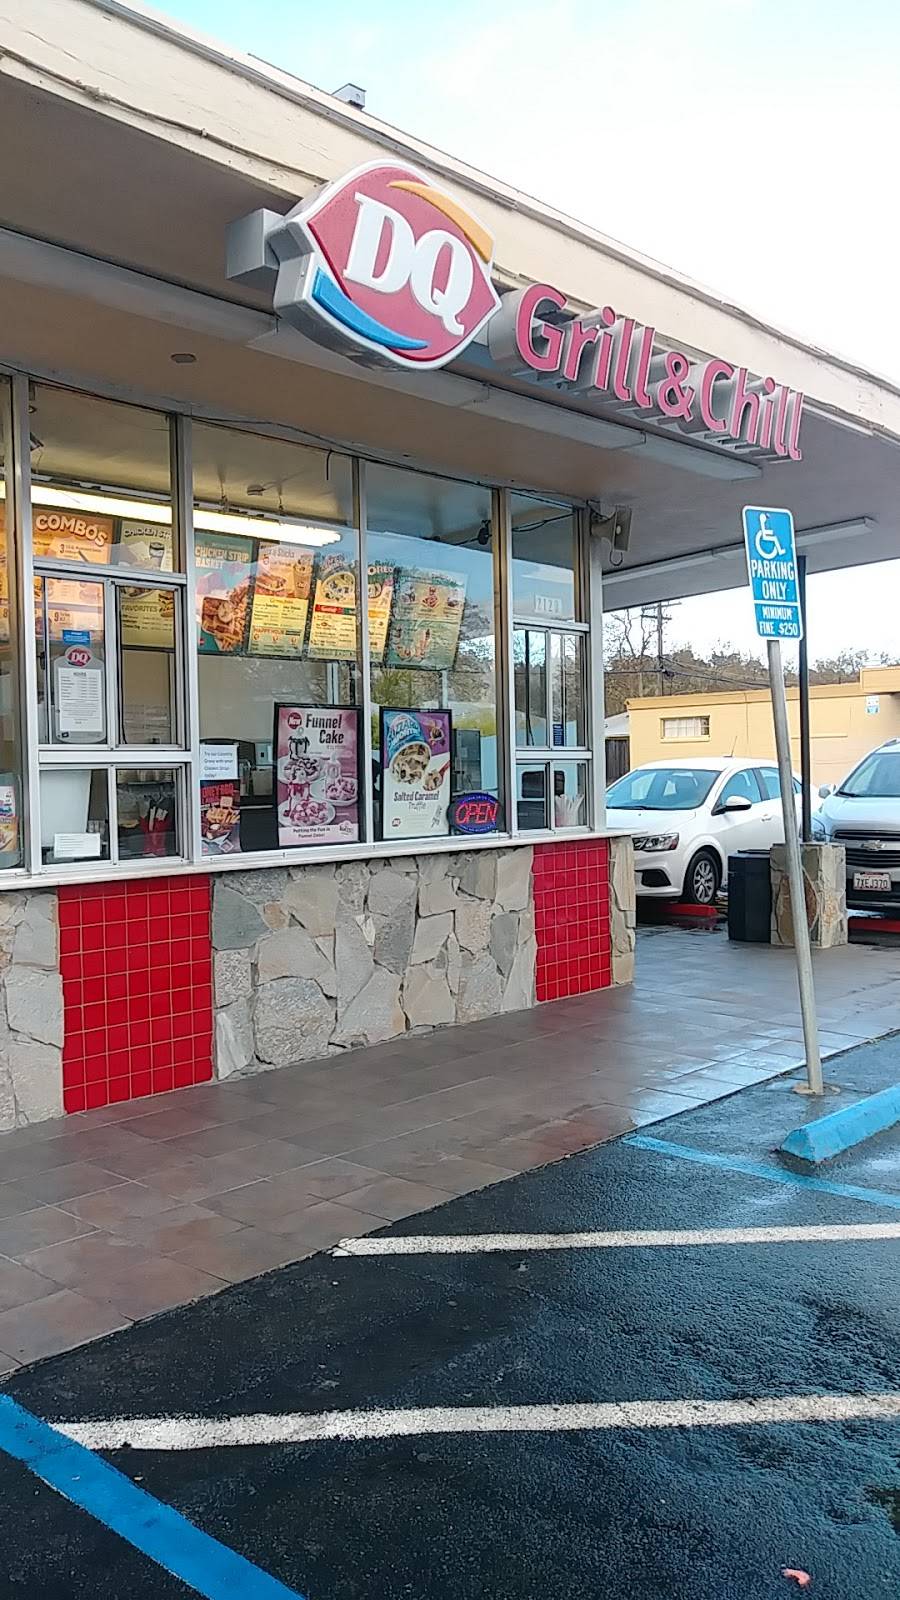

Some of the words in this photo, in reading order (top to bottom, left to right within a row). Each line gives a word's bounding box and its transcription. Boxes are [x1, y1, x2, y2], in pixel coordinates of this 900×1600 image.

[342, 192, 475, 337] DQ
[515, 283, 655, 408] Grill
[699, 359, 803, 461] Chill
[36, 514, 108, 547] COMBOS
[195, 545, 228, 560] CHICKEN
[228, 550, 249, 563] STRIP
[195, 557, 224, 569] BASKET
[368, 565, 394, 576] OREO
[751, 559, 794, 580] PARKING
[762, 581, 787, 600] ONLY
[121, 604, 158, 613] FAVORITES
[762, 606, 792, 620] MINIMUM
[760, 621, 775, 635] FINE
[778, 622, 798, 636] $250
[71, 652, 88, 664] DQ
[306, 713, 342, 729] Funnel
[319, 729, 344, 744] Cake
[394, 791, 414, 802] Salted
[415, 790, 439, 801] Caramel
[456, 802, 498, 824] OPEN
